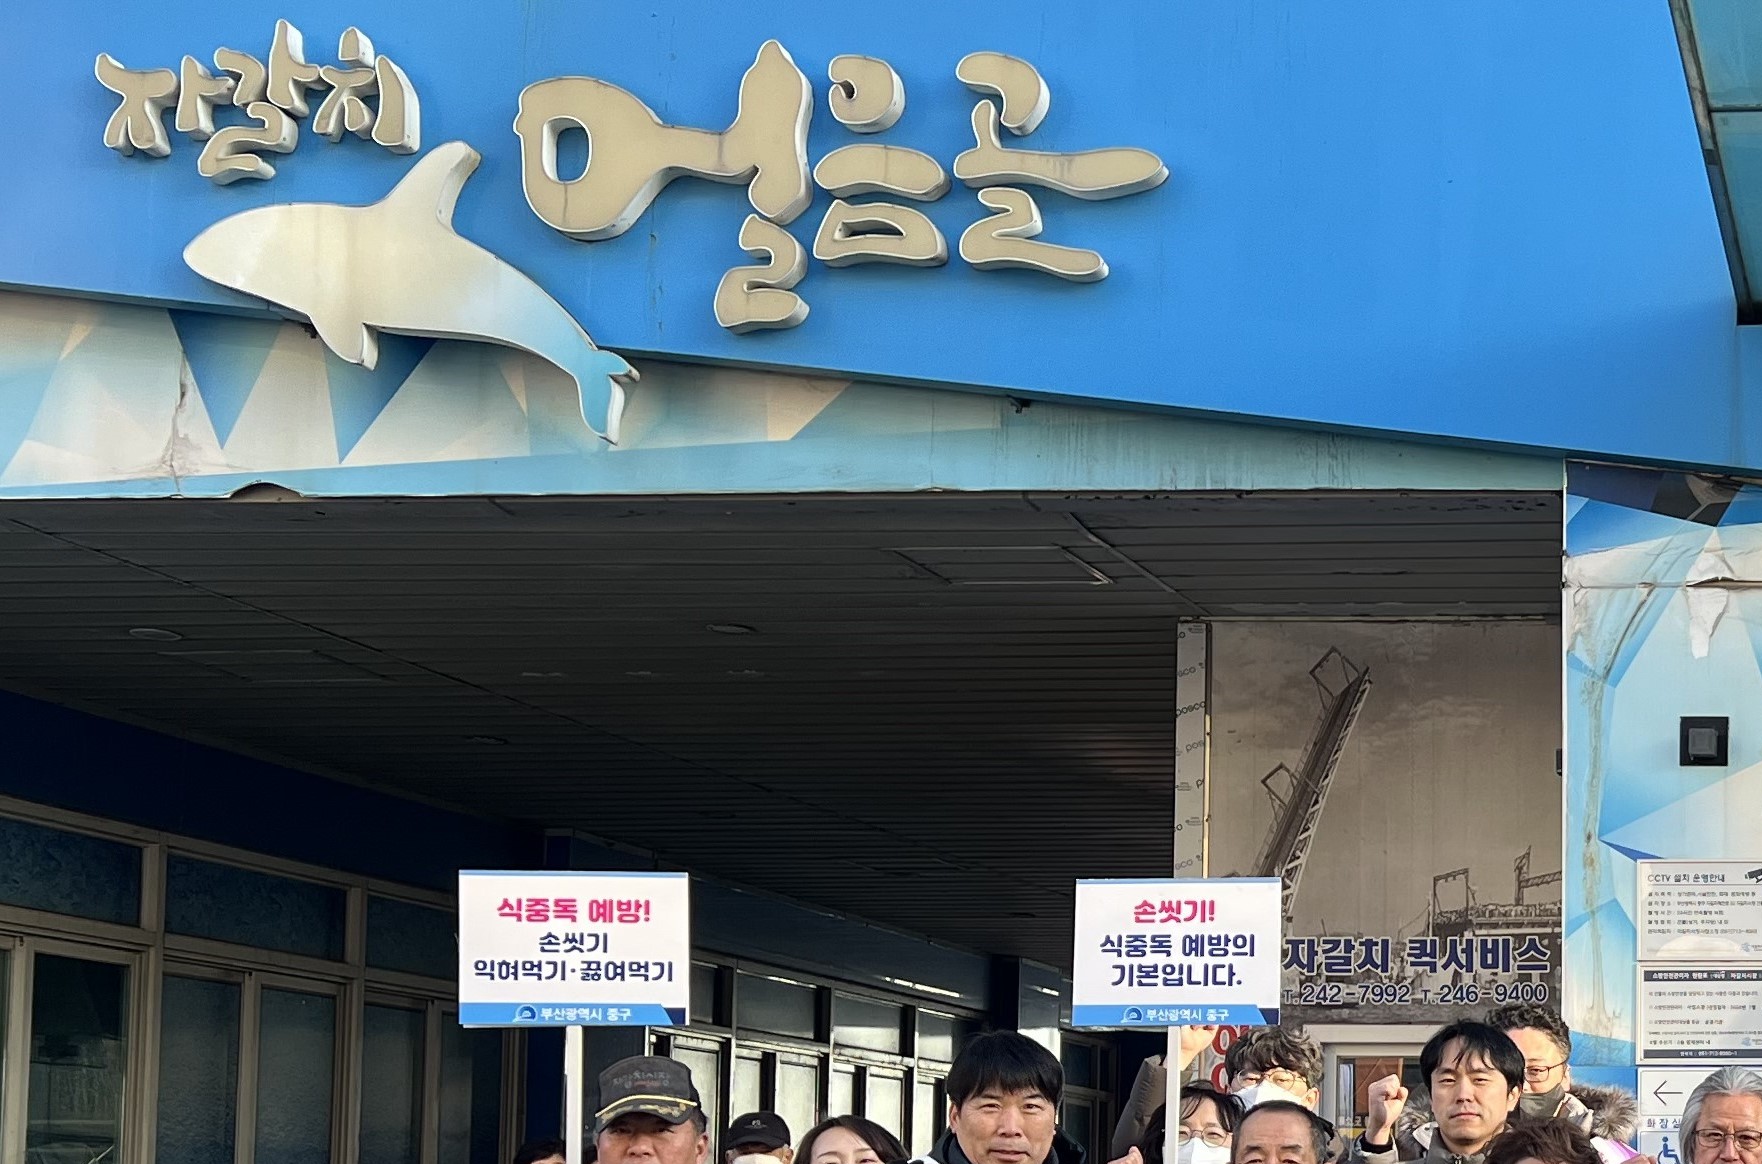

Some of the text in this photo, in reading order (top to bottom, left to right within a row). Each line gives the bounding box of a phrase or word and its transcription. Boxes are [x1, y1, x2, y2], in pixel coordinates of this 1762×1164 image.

[94, 18, 422, 185] 자갈치
[513, 38, 1170, 334] 얼음골
[1647, 874, 1671, 883] CCTV
[497, 898, 651, 924] 식중독 예방!
[1133, 898, 1216, 925] 손씻기!
[539, 932, 609, 954] 손씻기
[1100, 933, 1256, 958] 식중독 예방의
[1282, 935, 1551, 976] 자갈치 퀵서비스
[1111, 962, 1243, 988] 기본입니다.
